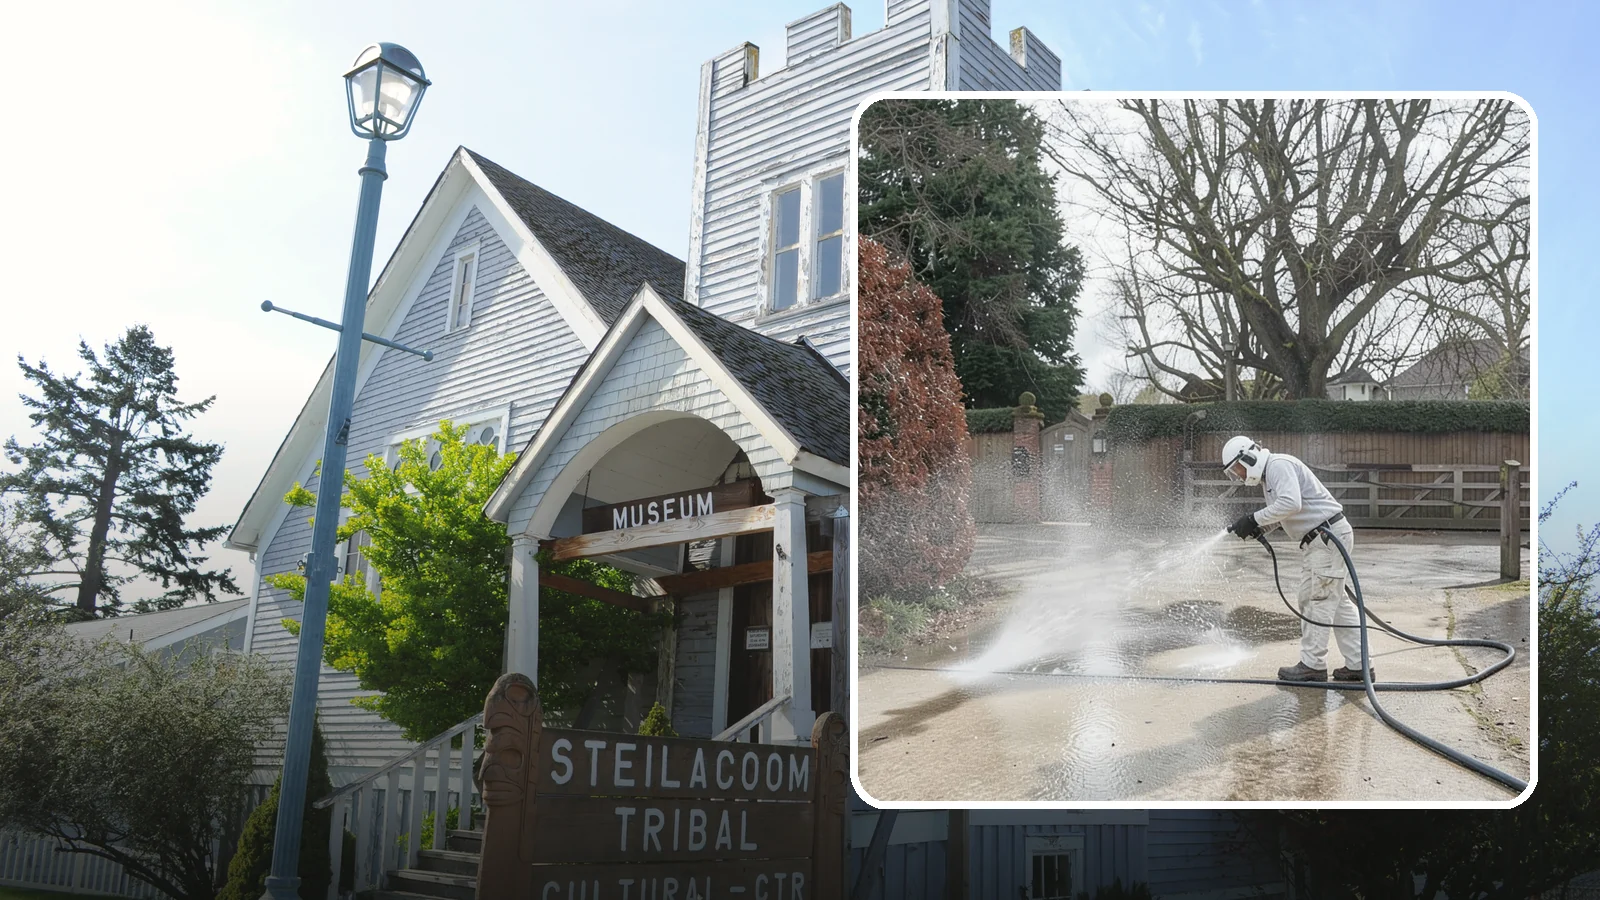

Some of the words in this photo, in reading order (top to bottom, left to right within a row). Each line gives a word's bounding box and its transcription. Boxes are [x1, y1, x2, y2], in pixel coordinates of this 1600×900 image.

[613, 492, 713, 530] MUSEUM
[551, 738, 809, 792] STEILACOOM
[615, 807, 757, 851] TRIBAL
